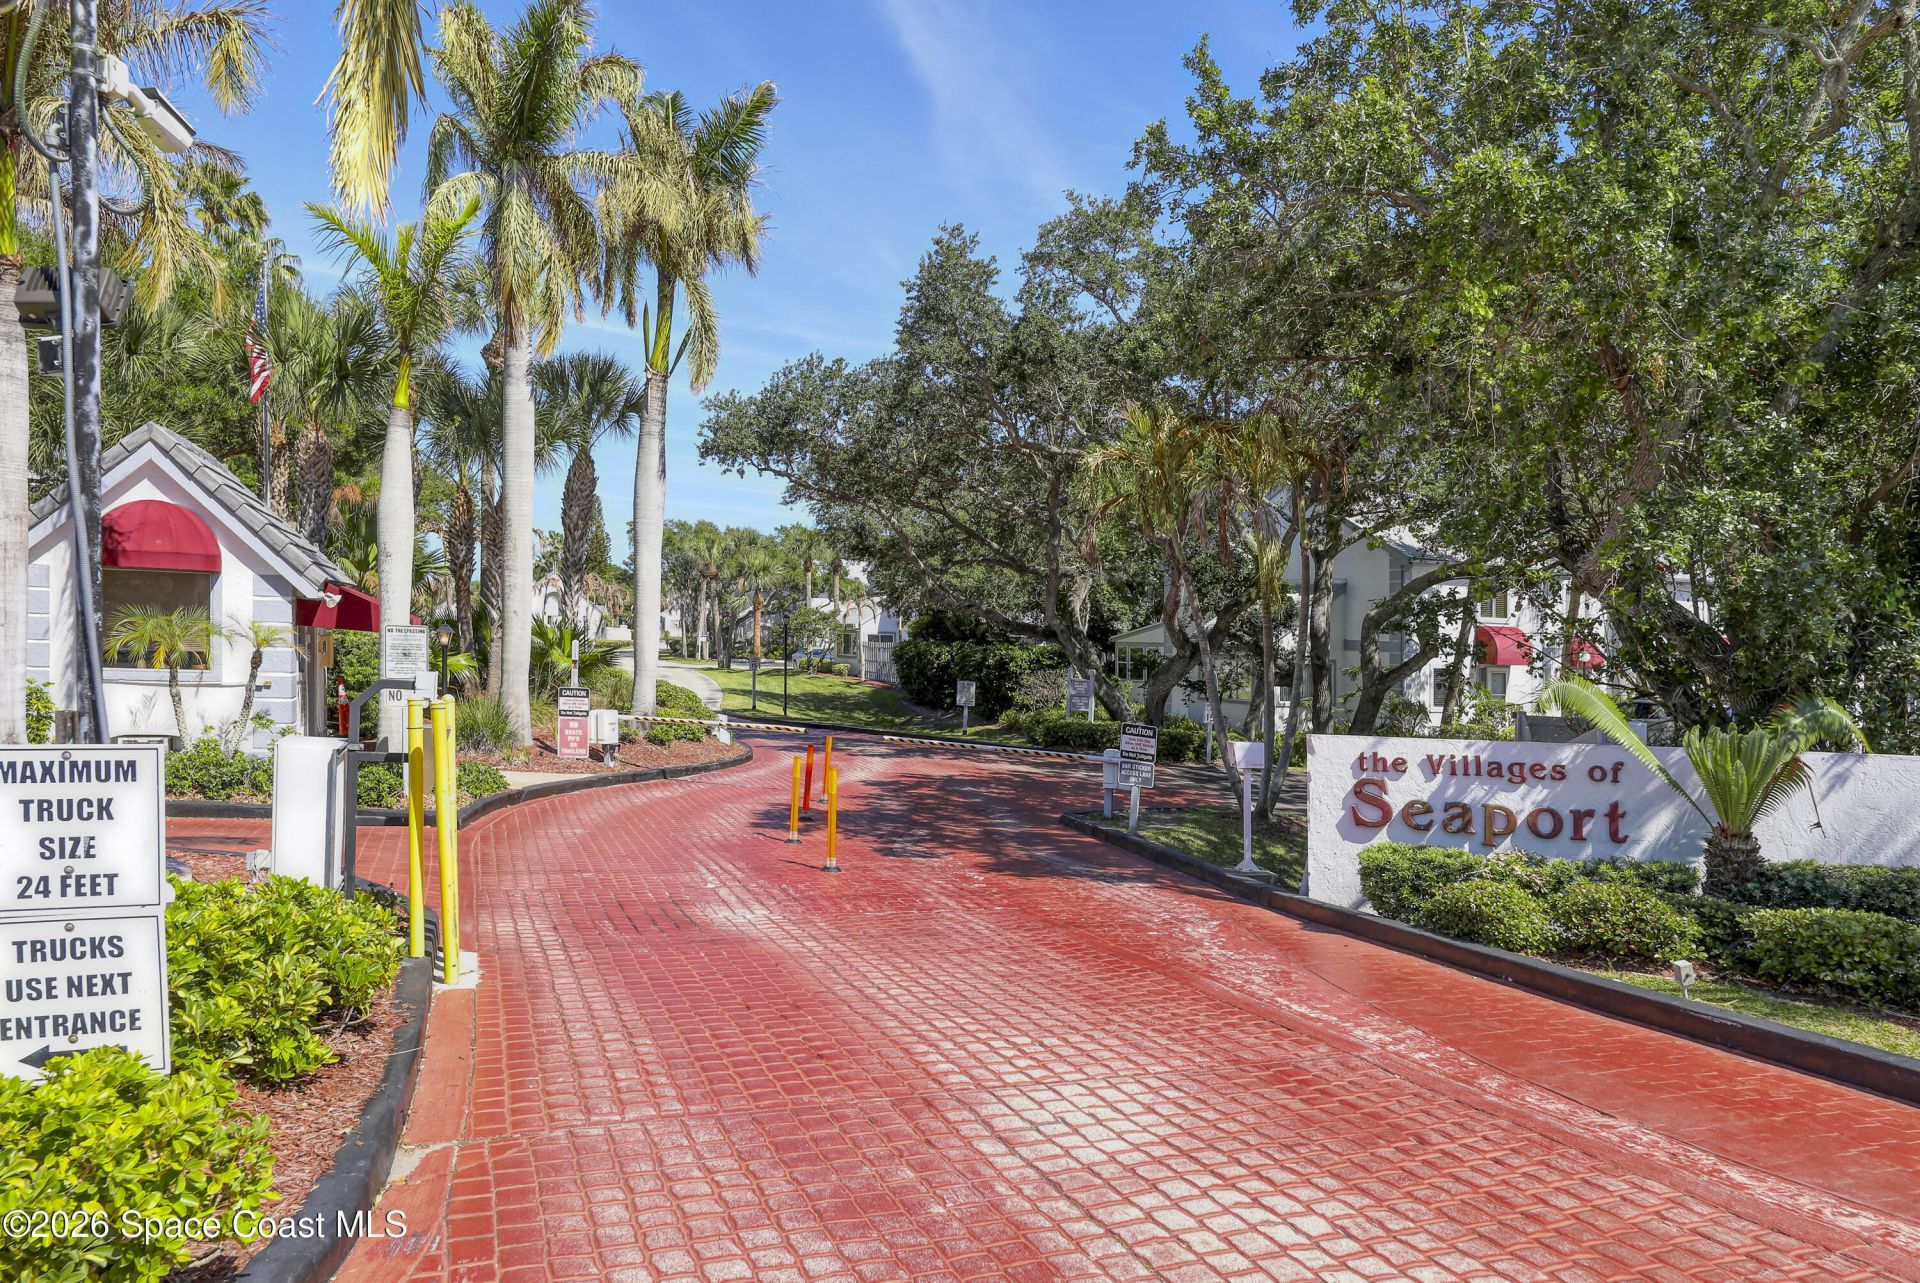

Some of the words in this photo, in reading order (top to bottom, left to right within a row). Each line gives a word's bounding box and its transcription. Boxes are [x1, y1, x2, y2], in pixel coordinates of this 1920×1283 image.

[388, 690, 403, 701] NO
[1126, 727, 1153, 737] CAUTION
[0, 760, 137, 784] MAXIMUM
[1132, 764, 1152, 772] STICKER
[1357, 751, 1408, 774] the
[1426, 754, 1567, 784] Villages
[1587, 761, 1625, 784] of
[18, 798, 114, 822] TRUCK
[1351, 777, 1629, 847] Seaport
[39, 836, 96, 860] SIZE
[16, 875, 51, 899] 24
[60, 873, 119, 898] FEET
[12, 935, 124, 963] TRUCKS
[6, 977, 58, 1002] USE
[67, 972, 132, 998] NEXT
[0, 1009, 142, 1041] ENTRANCE
